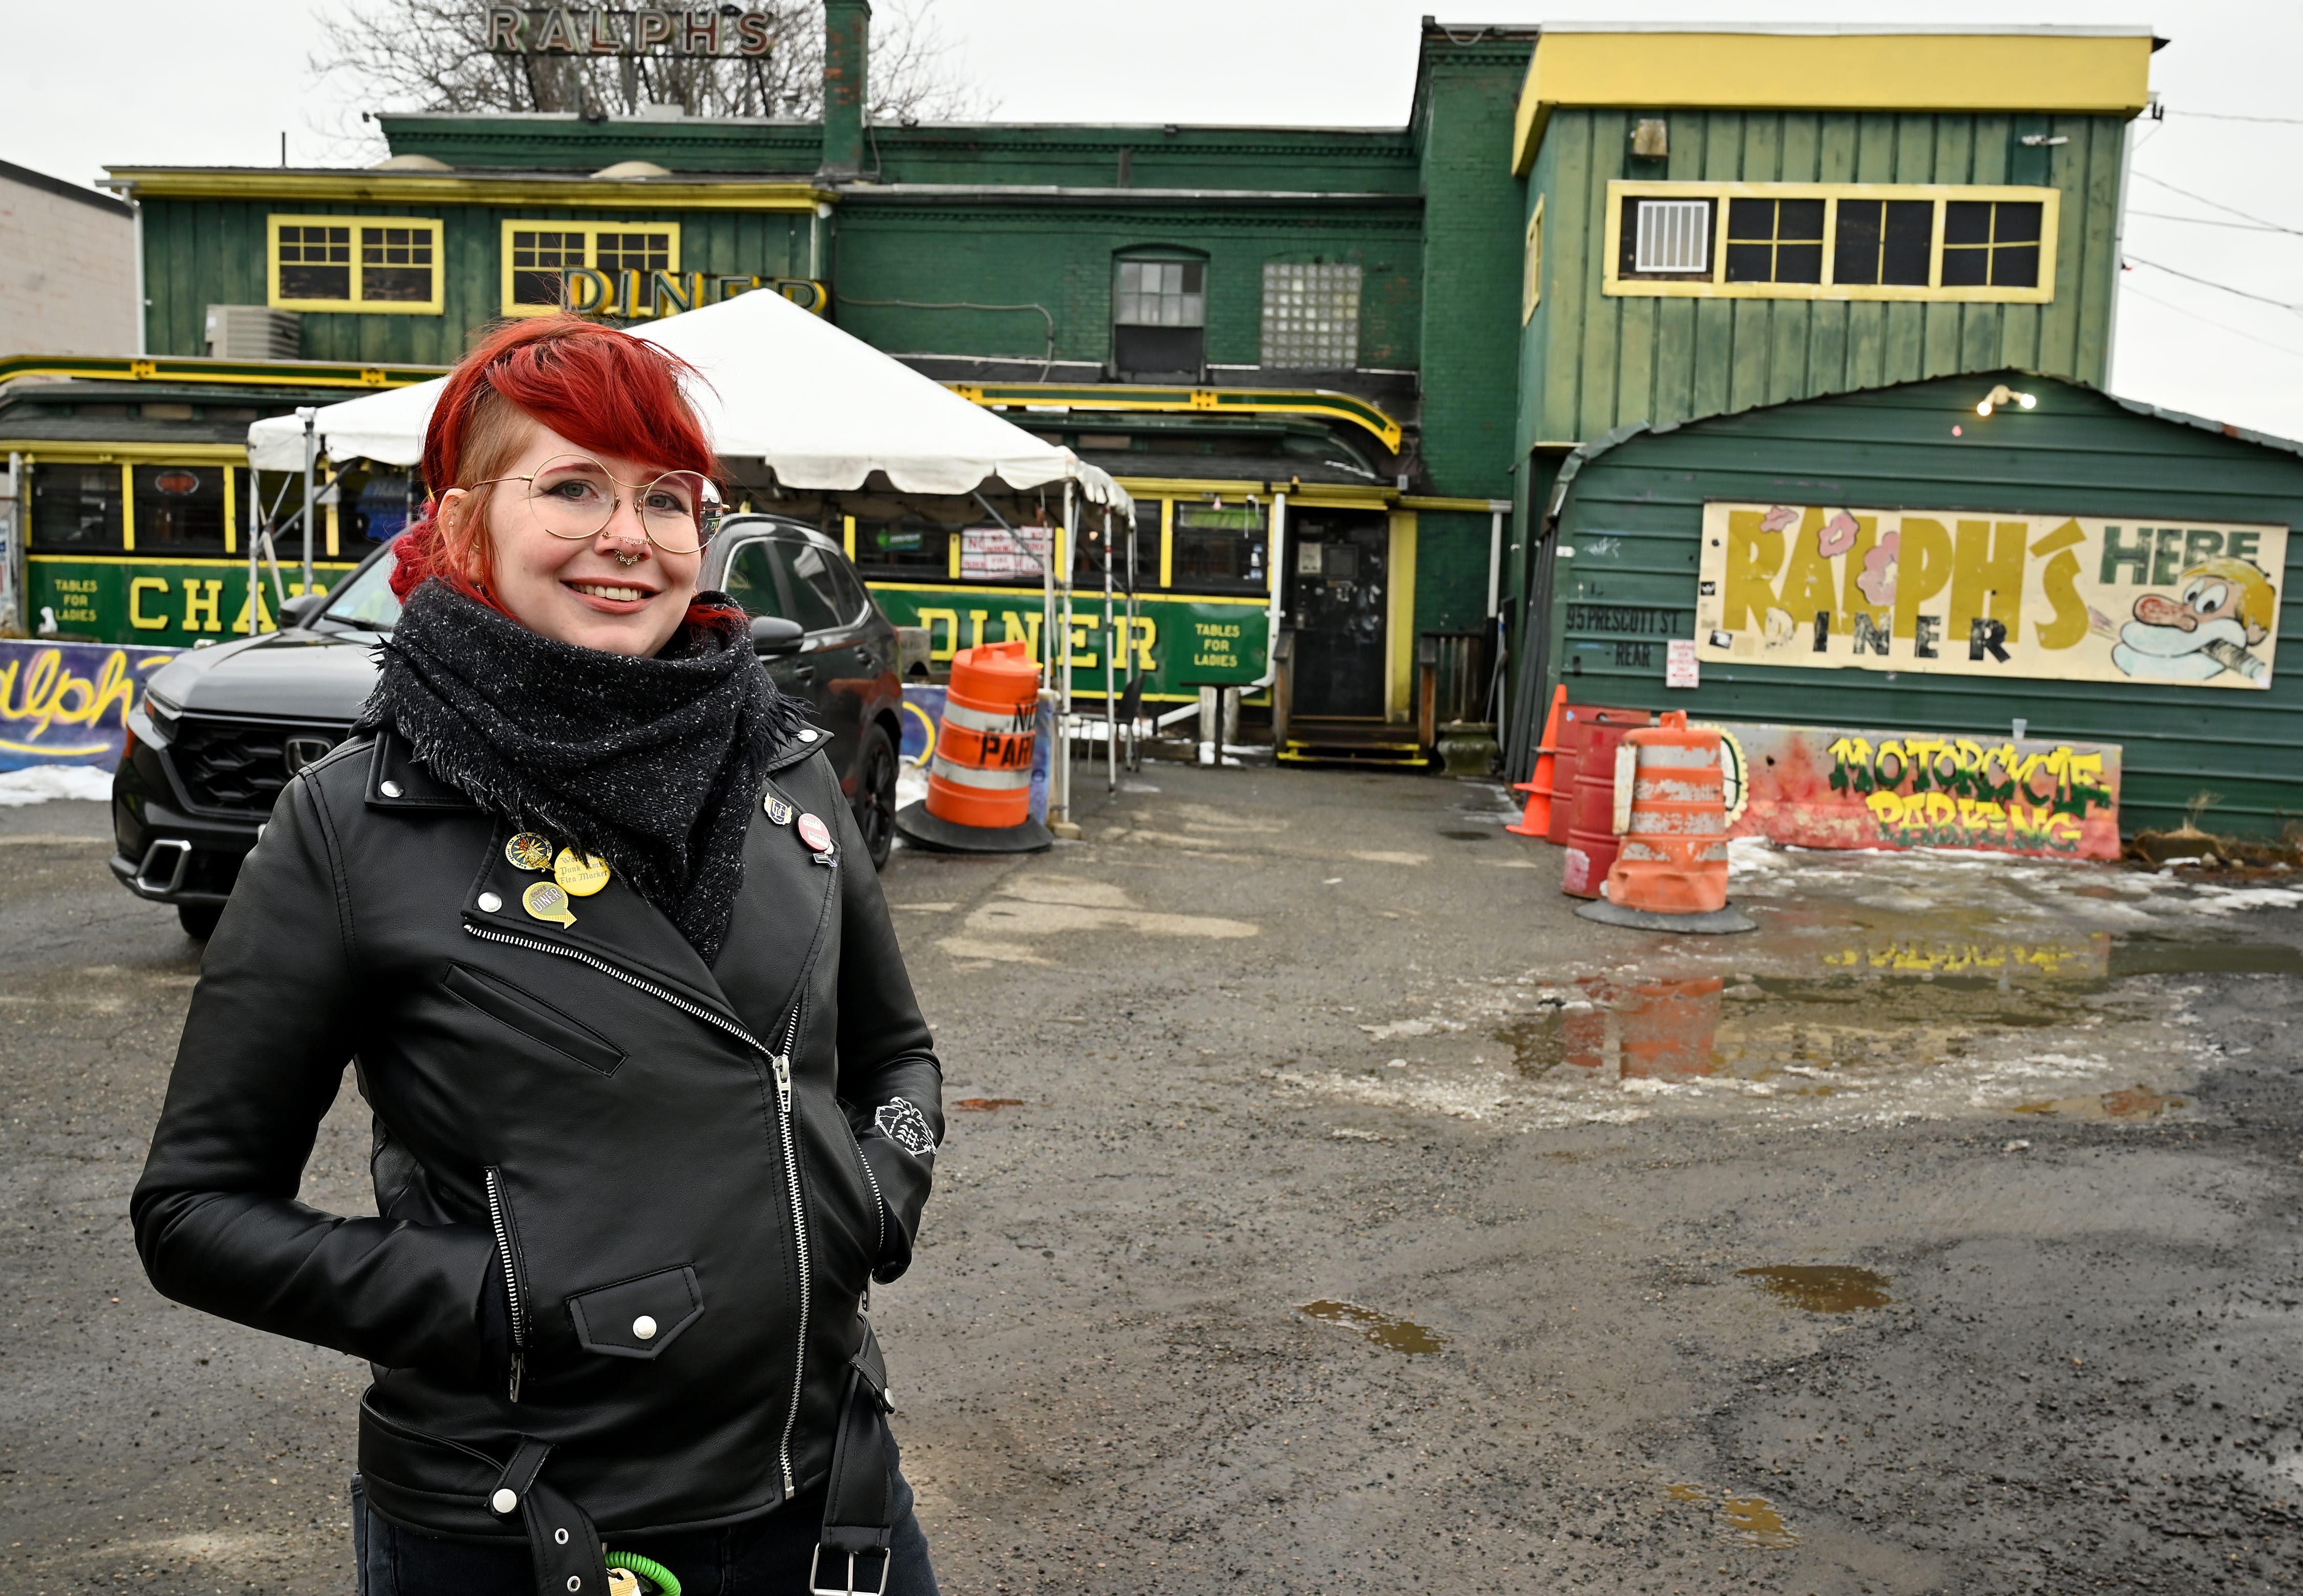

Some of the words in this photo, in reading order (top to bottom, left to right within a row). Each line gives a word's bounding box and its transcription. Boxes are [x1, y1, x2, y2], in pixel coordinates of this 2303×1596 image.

[2099, 526, 2261, 586] HERE
[54, 579, 98, 593] TABLES
[63, 594, 88, 607] FOR
[55, 608, 97, 622] LADIES
[1567, 604, 1584, 630] 95
[1588, 605, 1655, 633] PRESCOTT
[1194, 623, 1241, 638] TABLES
[1765, 607, 2010, 663] DINER
[918, 608, 1157, 670] DINER
[1204, 639, 1229, 652] FOR
[1194, 653, 1237, 668] LADIES
[1616, 642, 1651, 667] REAR
[1828, 737, 2112, 817] MOTORCYCLE
[803, 816, 820, 825] NASTY
[1865, 790, 2082, 851] PARKING
[809, 831, 828, 843] WOMEN
[559, 865, 581, 876] Punk
[559, 877, 576, 885] Flea
[578, 870, 607, 881] Market
[530, 887, 562, 912] DINER
